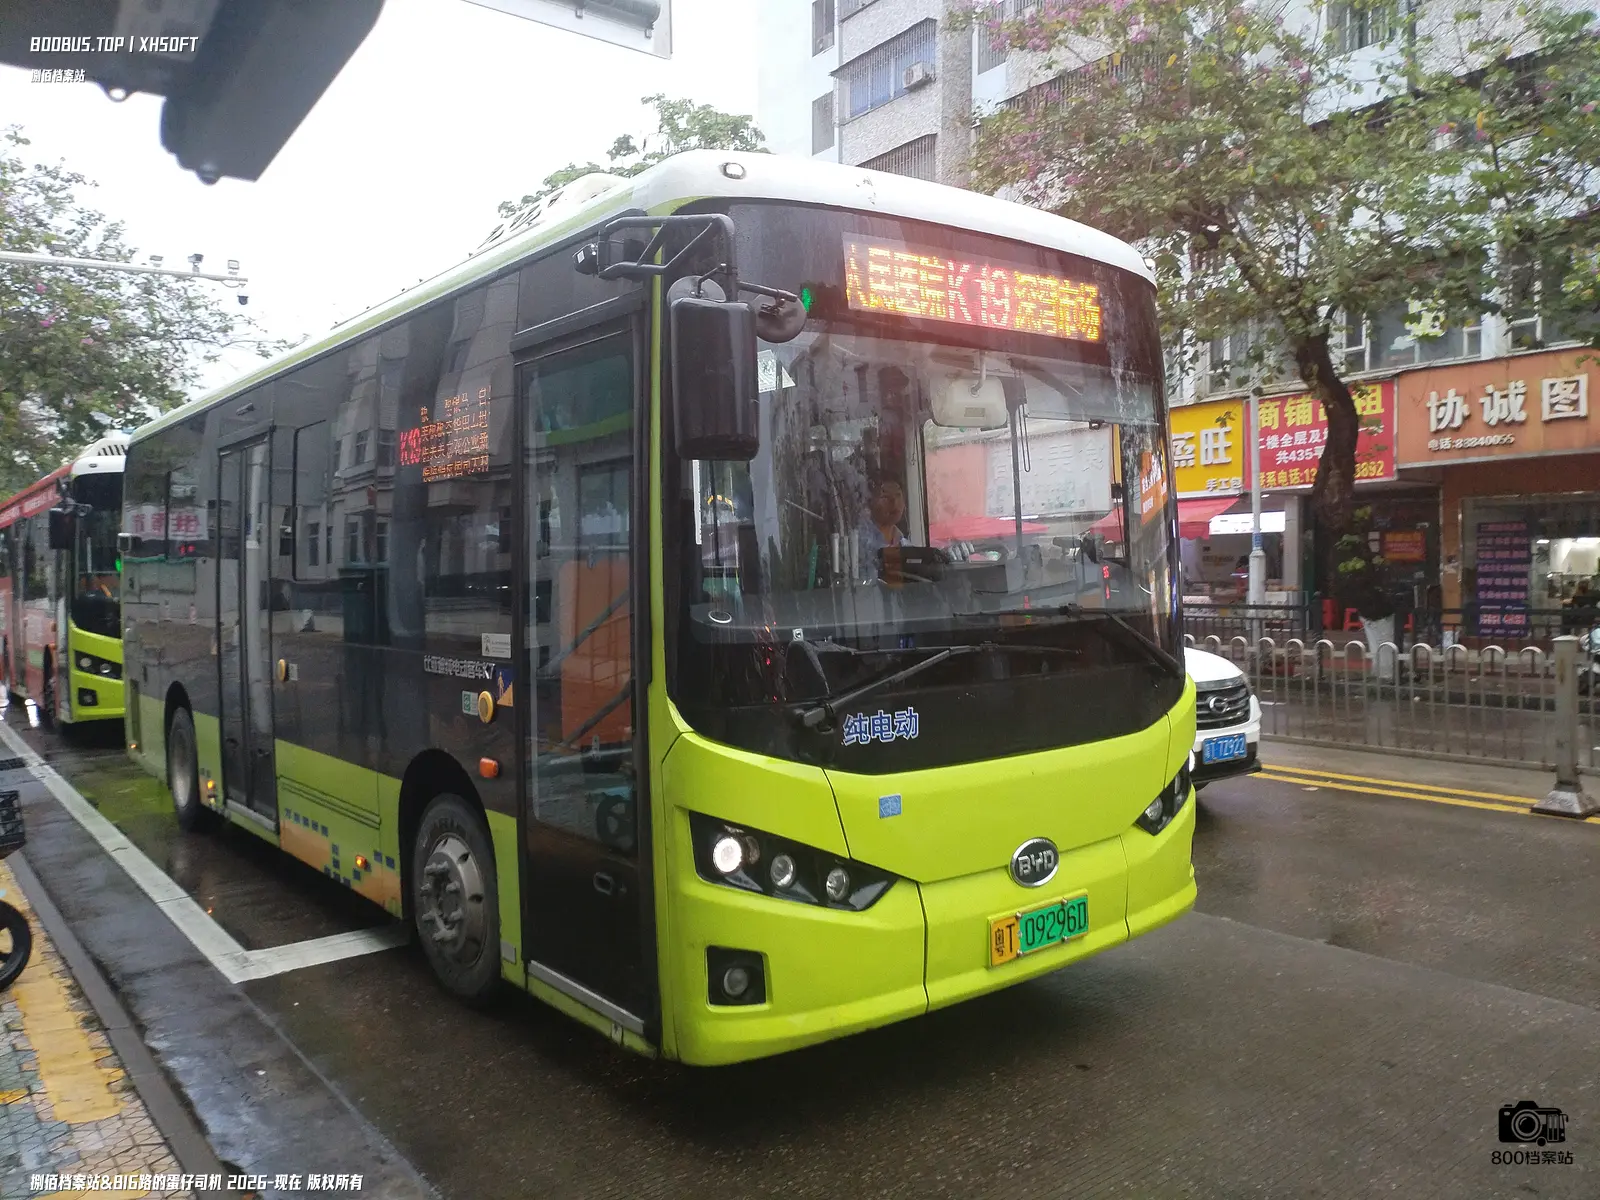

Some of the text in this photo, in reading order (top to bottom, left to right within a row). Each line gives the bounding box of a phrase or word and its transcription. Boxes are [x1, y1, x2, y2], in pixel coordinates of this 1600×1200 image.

[846, 244, 947, 318] 人民医院
[947, 259, 1011, 327] K19
[1426, 373, 1588, 433] 协诚图
[843, 706, 919, 746] 纯电动
[1017, 849, 1055, 876] BYD
